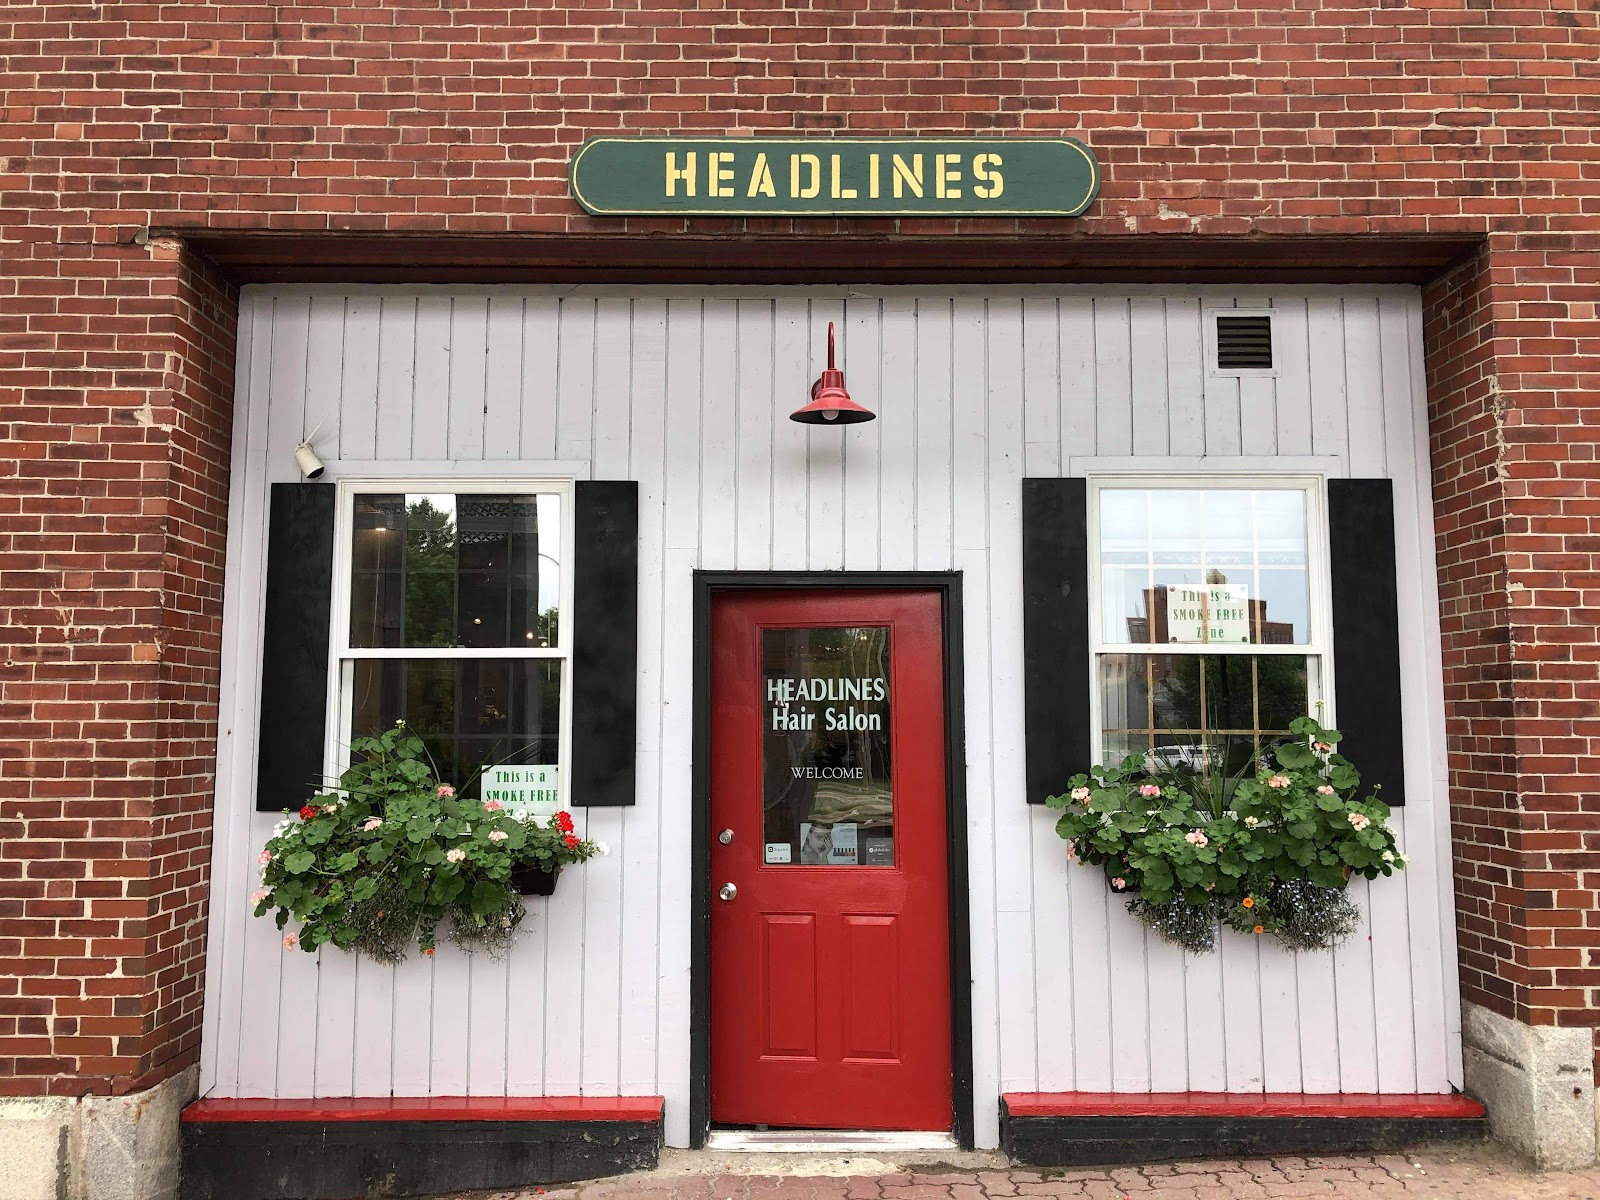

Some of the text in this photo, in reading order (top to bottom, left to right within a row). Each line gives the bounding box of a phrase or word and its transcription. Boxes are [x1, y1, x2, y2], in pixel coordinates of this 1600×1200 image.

[665, 151, 1004, 199] HEADLINES
[1182, 590, 1231, 602] Thi is a
[1216, 608, 1245, 621] FREE
[1196, 626, 1225, 639] Zne
[767, 678, 885, 701] HEADLINES
[772, 706, 881, 731] Hair Salon
[495, 770, 546, 783] This is a
[791, 767, 864, 779] WELCOME
[486, 789, 558, 802] SMOKE FREE
